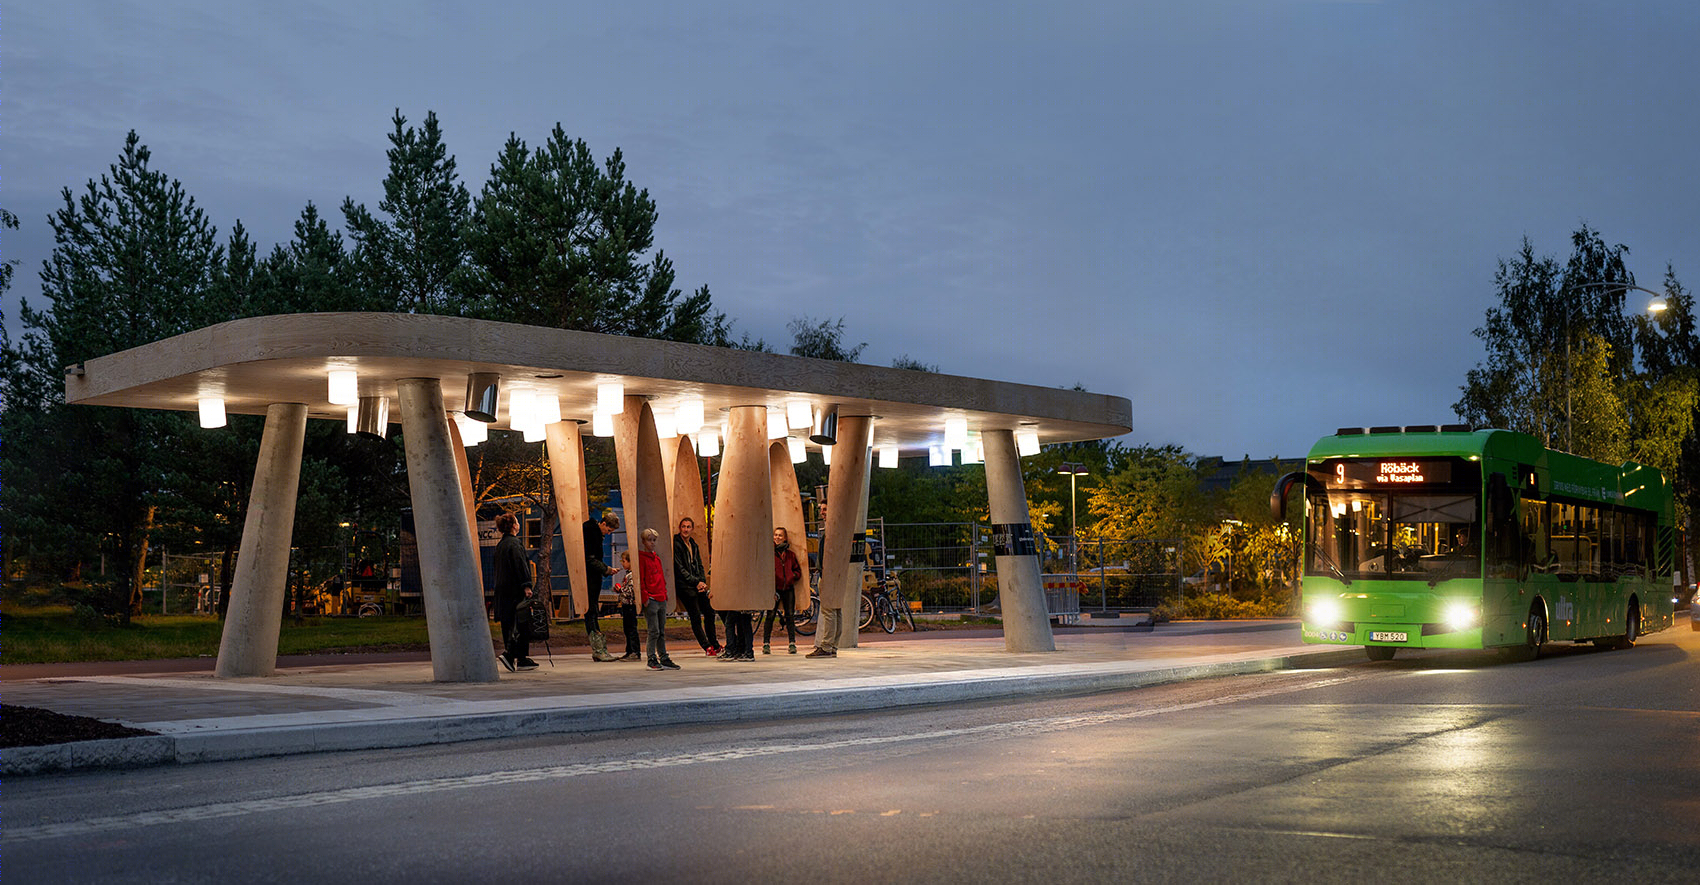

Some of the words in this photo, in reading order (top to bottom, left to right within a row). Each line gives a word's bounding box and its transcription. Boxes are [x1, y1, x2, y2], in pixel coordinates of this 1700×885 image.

[1336, 463, 1345, 484] 9
[1380, 462, 1420, 474] Röbäck
[1376, 473, 1388, 482] via
[1390, 473, 1424, 483] Vasaplan
[1555, 595, 1574, 620] ultra
